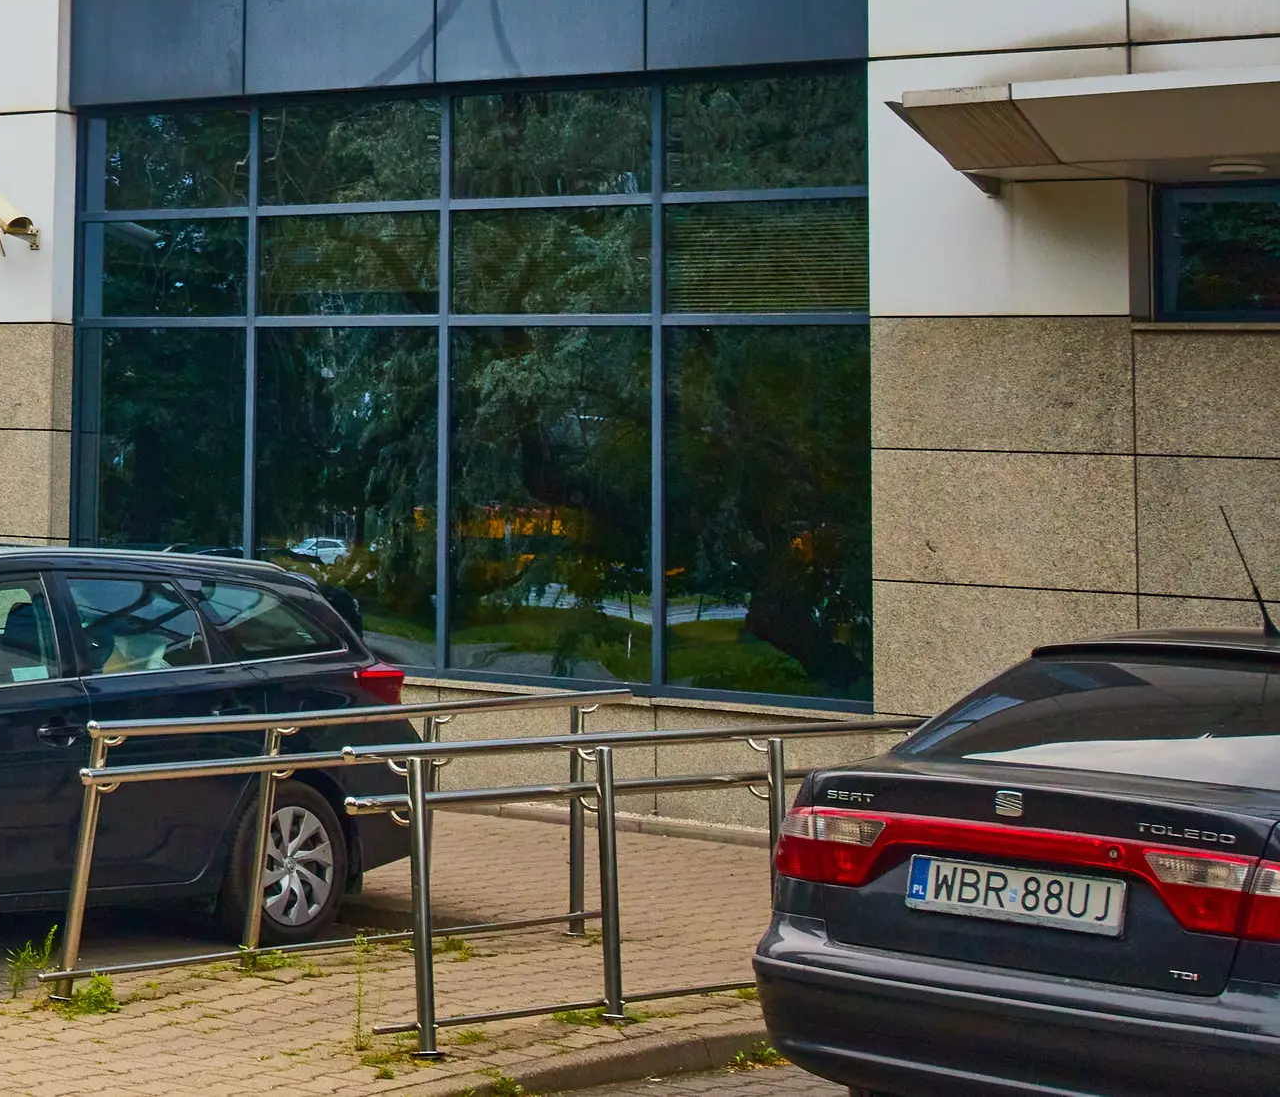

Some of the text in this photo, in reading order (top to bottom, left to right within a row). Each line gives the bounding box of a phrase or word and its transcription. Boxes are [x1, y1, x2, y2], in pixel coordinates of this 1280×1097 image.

[827, 789, 875, 803] SEAT
[1138, 822, 1236, 845] TOLEDO
[913, 884, 925, 895] PL
[934, 864, 1112, 922] WBR 88UJ
[1169, 969, 1199, 982] TDI
